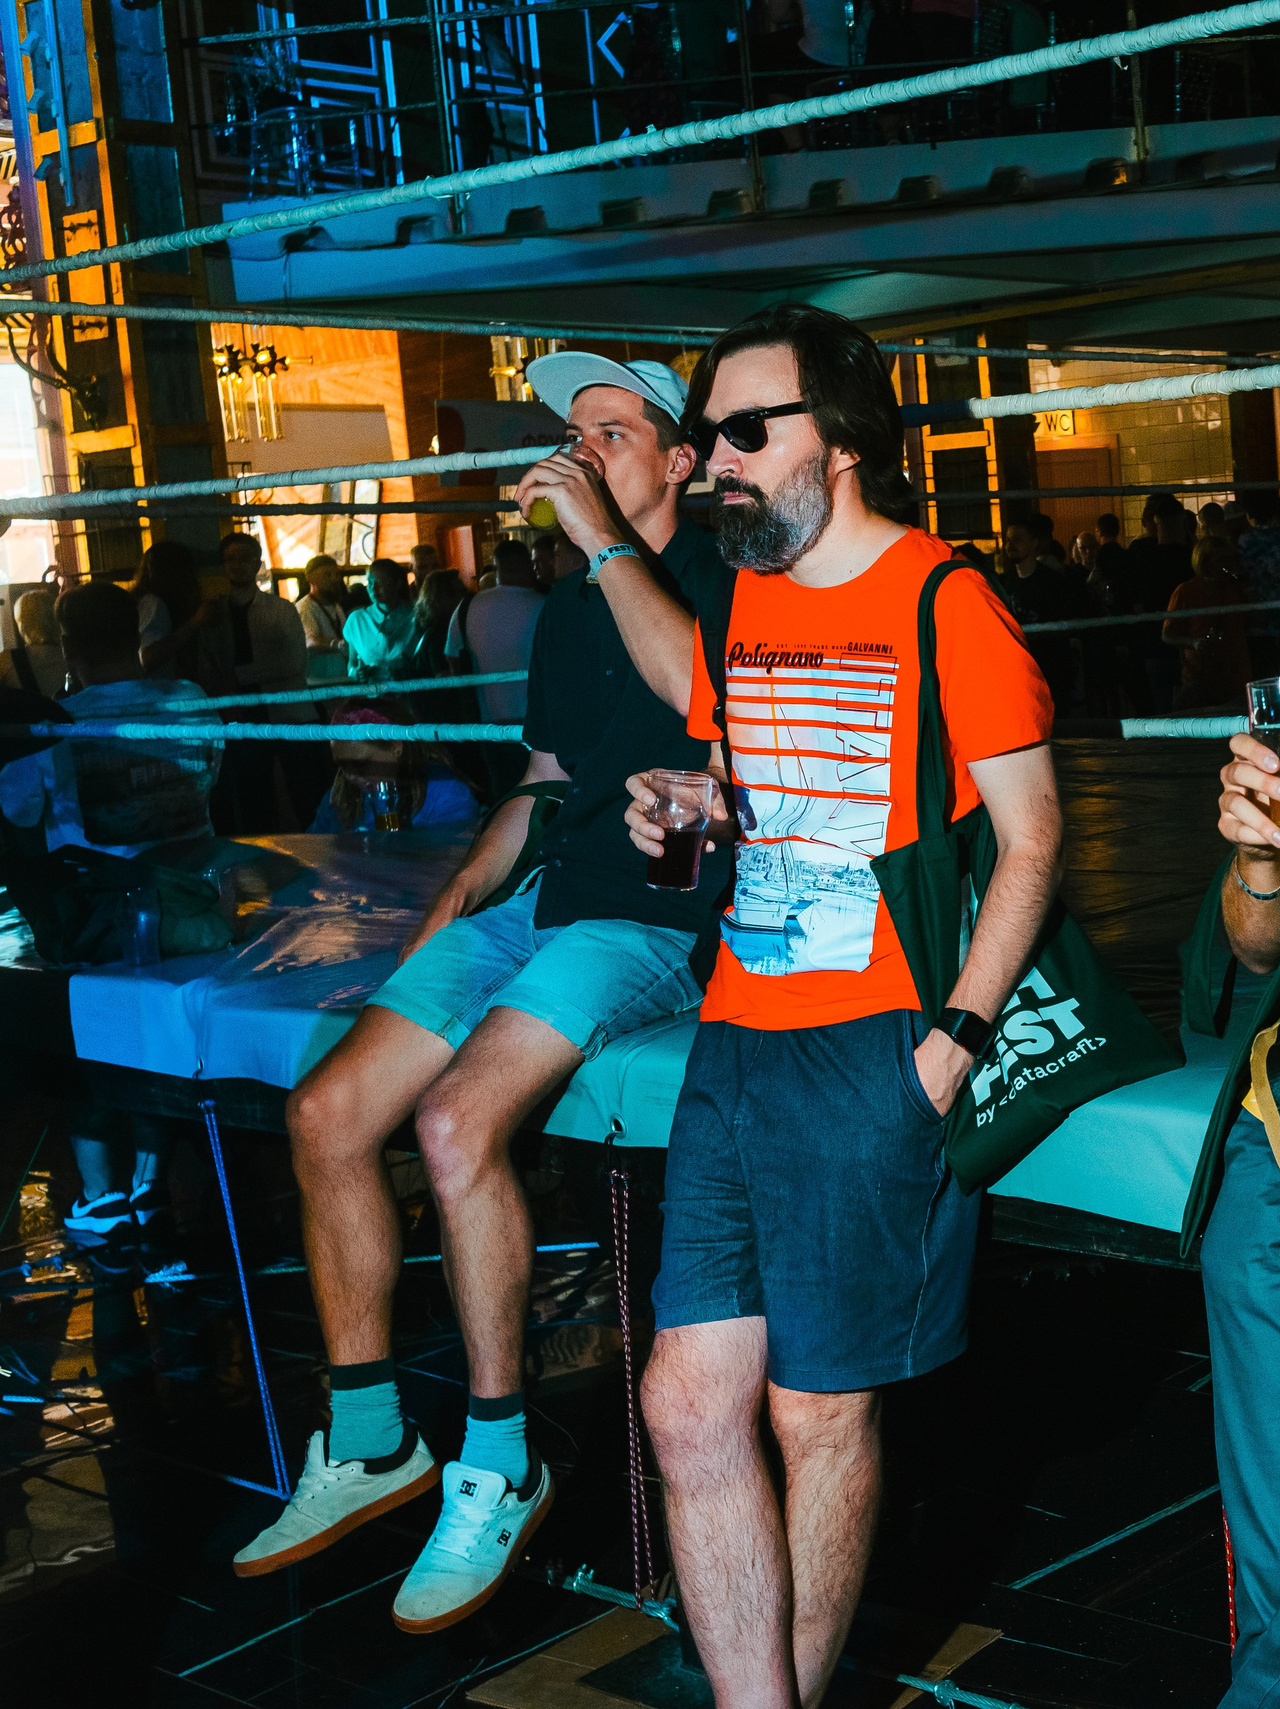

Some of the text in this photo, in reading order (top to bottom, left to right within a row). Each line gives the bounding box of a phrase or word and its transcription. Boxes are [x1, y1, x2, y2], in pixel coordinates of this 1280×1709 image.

[1045, 414, 1070, 431] WC
[607, 545, 631, 554] FEST
[847, 641, 893, 655] GALVANNI
[727, 641, 824, 675] Polignano
[976, 1104, 996, 1127] by
